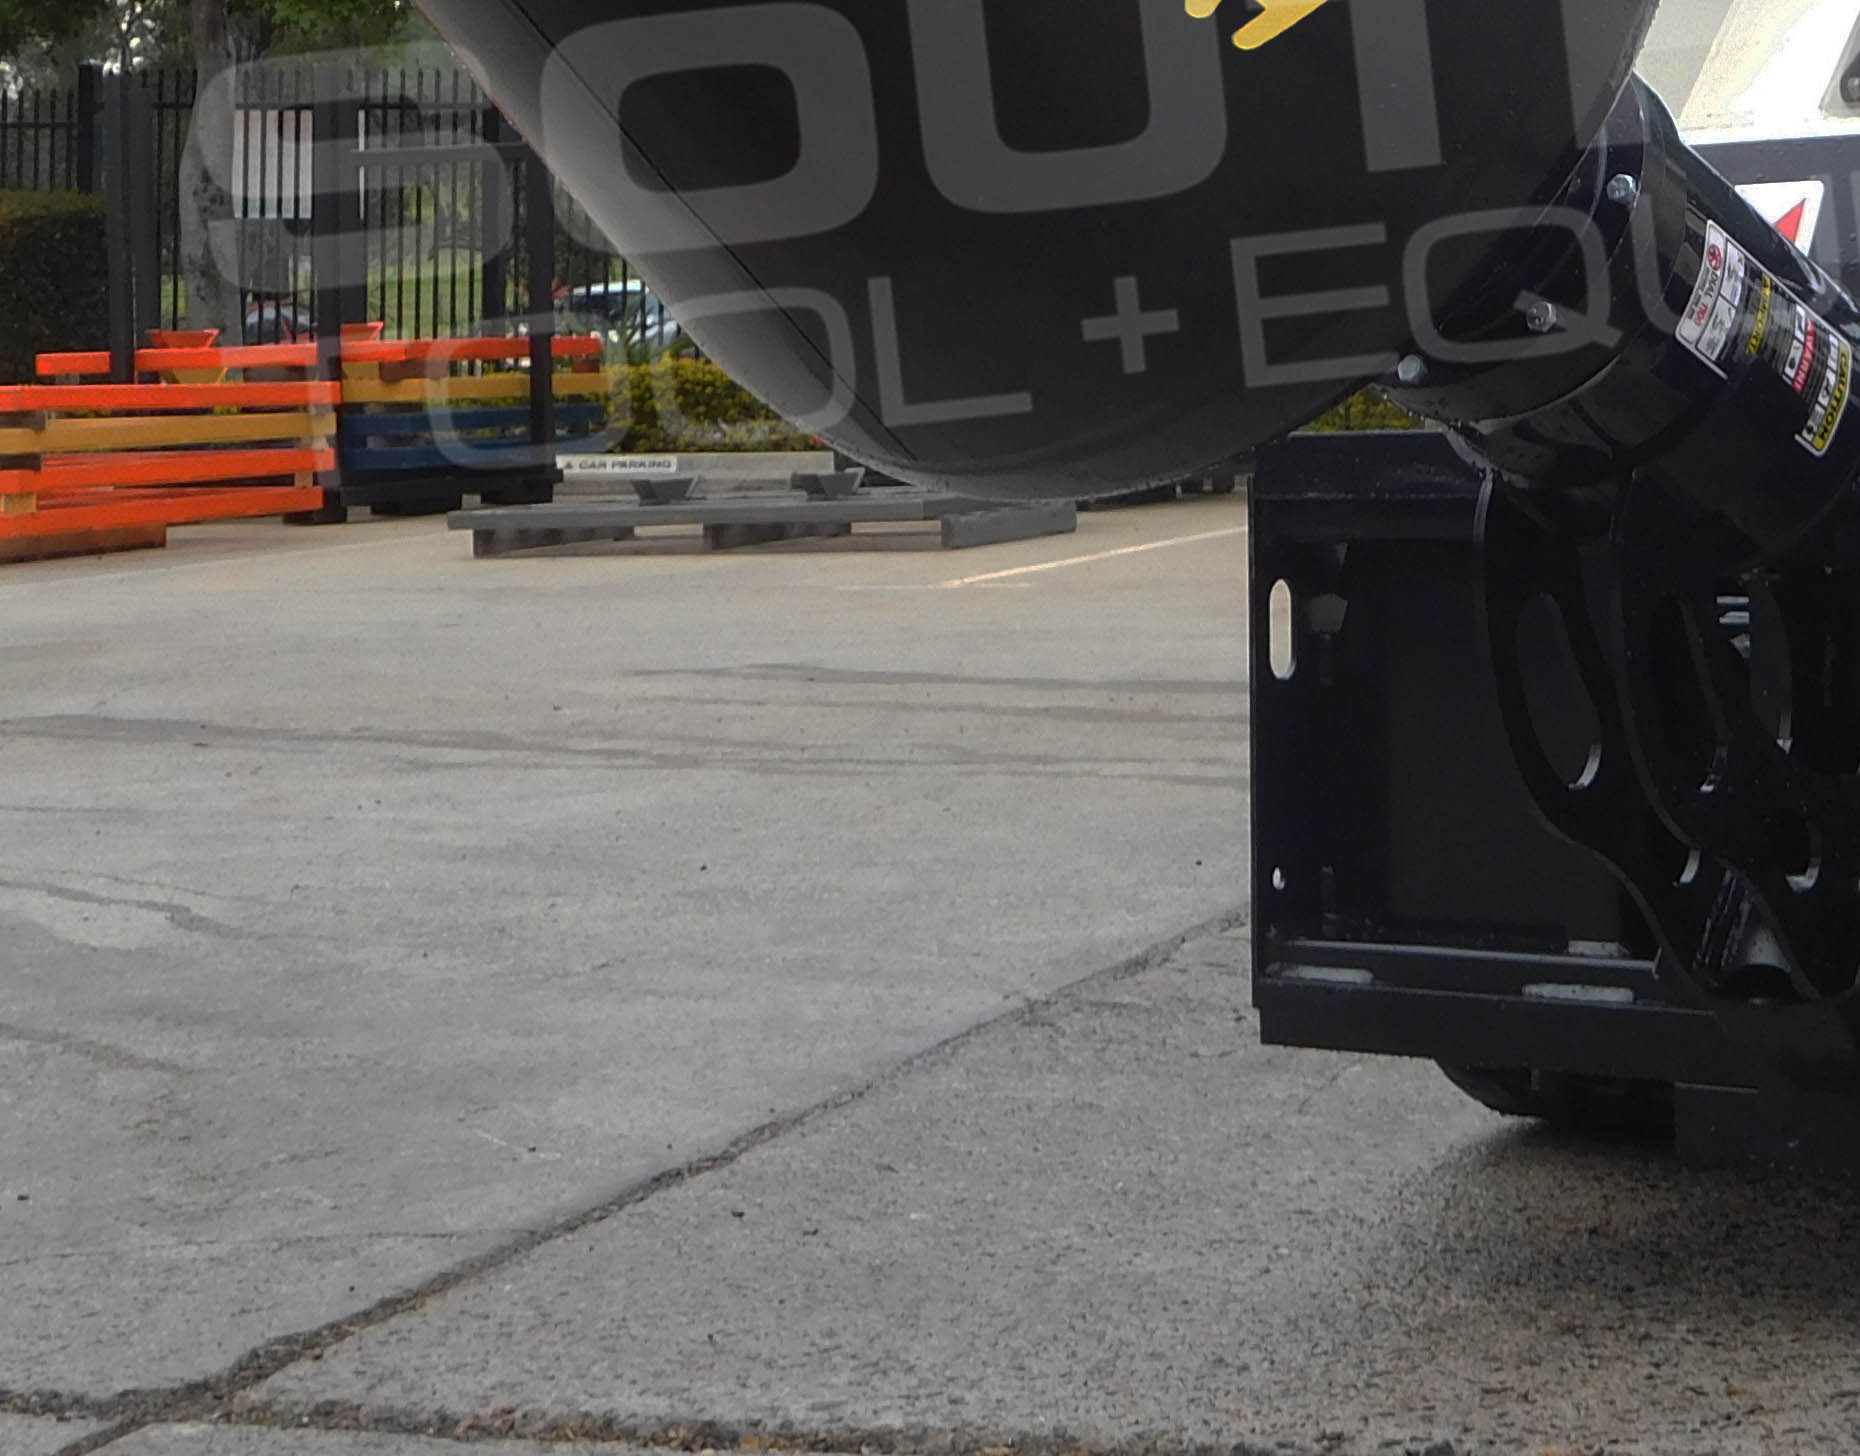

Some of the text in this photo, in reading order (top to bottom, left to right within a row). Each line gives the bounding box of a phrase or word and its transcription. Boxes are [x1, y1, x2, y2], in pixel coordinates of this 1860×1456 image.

[1817, 350, 1849, 440] CAUTION
[579, 458, 608, 470] CAR
[611, 458, 672, 470] PARKING
